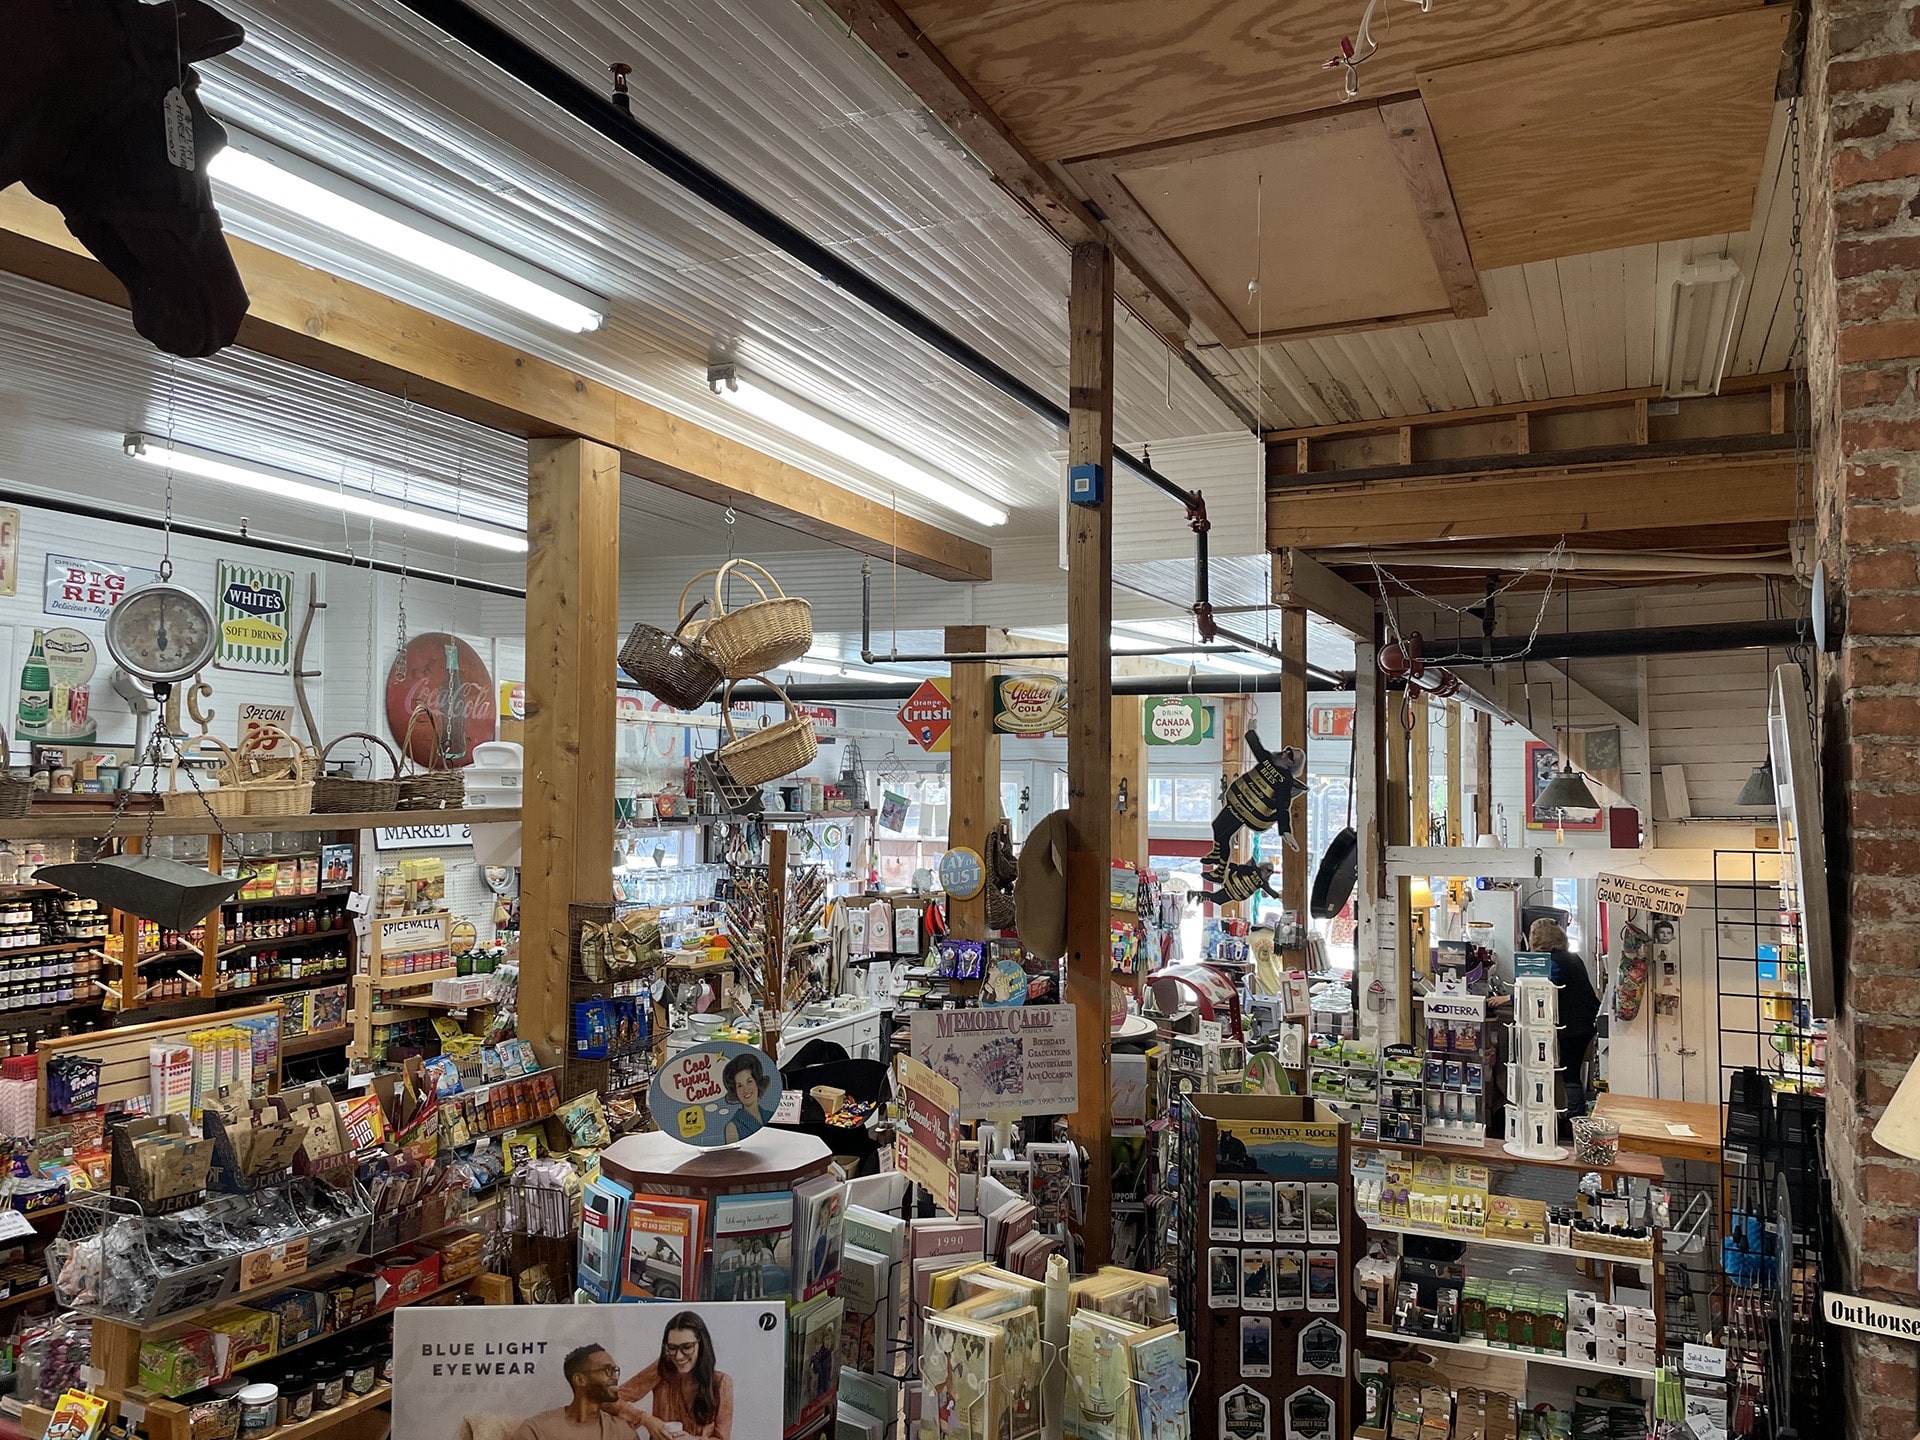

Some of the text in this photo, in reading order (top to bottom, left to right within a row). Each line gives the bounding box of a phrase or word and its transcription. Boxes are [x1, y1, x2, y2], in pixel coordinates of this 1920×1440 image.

[66, 567, 125, 591] BIG
[229, 589, 282, 610] WHITE'S
[225, 624, 283, 642] SOFT DRINKS
[1010, 681, 1052, 709] Golden
[243, 705, 287, 722] SPECIAL
[903, 706, 951, 724] Crush
[1017, 705, 1042, 714] COLA
[1155, 718, 1191, 727] CANADA
[1163, 727, 1182, 737] DRY
[1260, 767, 1277, 785] BEES
[1262, 759, 1286, 784] BURT'S
[384, 824, 452, 840] MARKET
[941, 855, 964, 872] LAY
[942, 866, 981, 886] BUST
[1613, 877, 1672, 898] WELCOME
[1597, 886, 1685, 915] GRAND CENTRAL STATION
[383, 918, 441, 937] SPICEWALLA
[1428, 1003, 1480, 1017] MEDTERRA
[935, 1011, 1008, 1039] MEMORY
[1008, 1008, 1052, 1034] CARD
[1032, 1037, 1066, 1046] BIRTHDAYS
[1028, 1049, 1072, 1058] GRADUATIONS
[682, 1054, 711, 1075] Cool
[1026, 1060, 1073, 1069] ANNIVERSARIES
[673, 1070, 711, 1091] Funny
[1026, 1070, 1074, 1081] ANY OCCASION
[685, 1082, 722, 1103] Cards
[1249, 1126, 1338, 1139] CHIMNEY ROCK
[316, 1154, 349, 1172] JERKY
[253, 1169, 287, 1190] JERKY
[158, 1192, 200, 1213] JERKY
[853, 1226, 876, 1242] 1980
[936, 1235, 964, 1248] 1990
[1831, 1299, 1920, 1337] Outhouse
[421, 1341, 548, 1357] BLUE LIGHT
[432, 1361, 536, 1377] EYEWEAR
